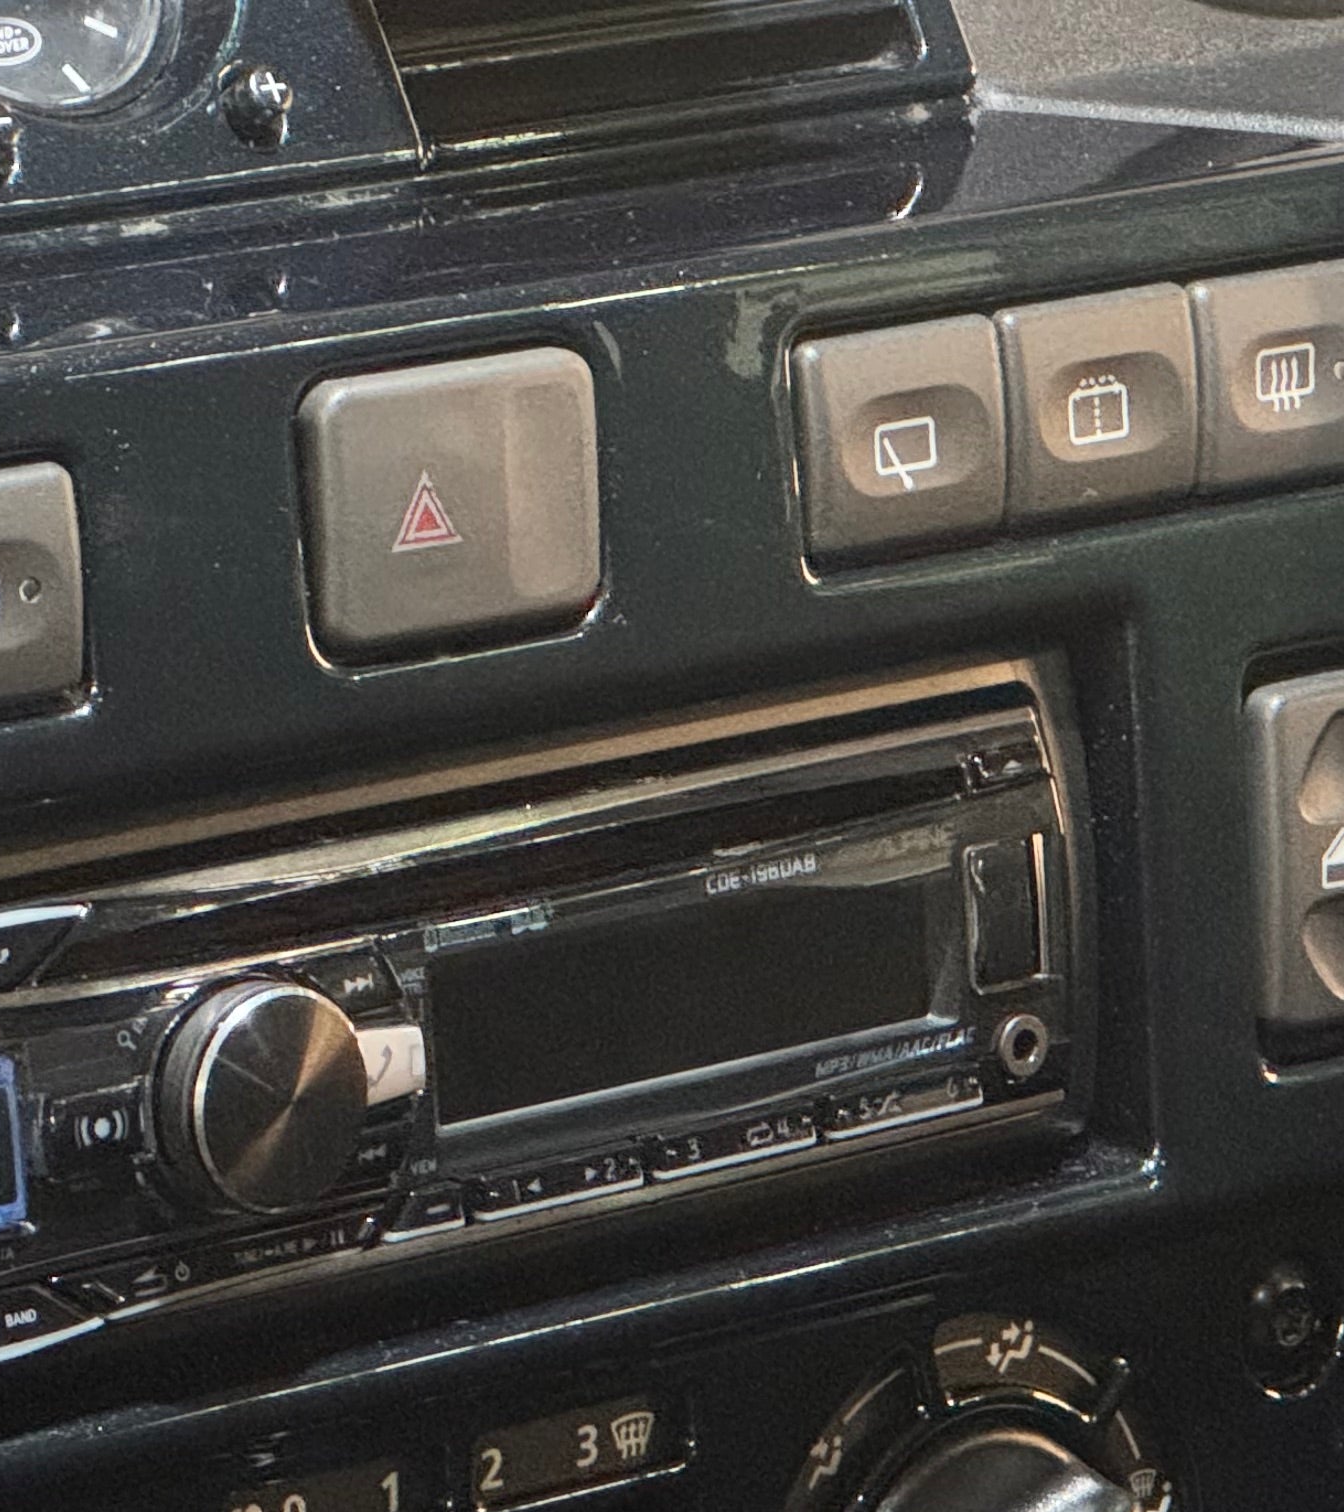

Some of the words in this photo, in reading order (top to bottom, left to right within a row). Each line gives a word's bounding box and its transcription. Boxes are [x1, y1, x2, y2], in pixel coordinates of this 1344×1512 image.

[4, 1307, 38, 1328] BAND
[480, 1447, 504, 1492] 2
[575, 1424, 599, 1468] 3
